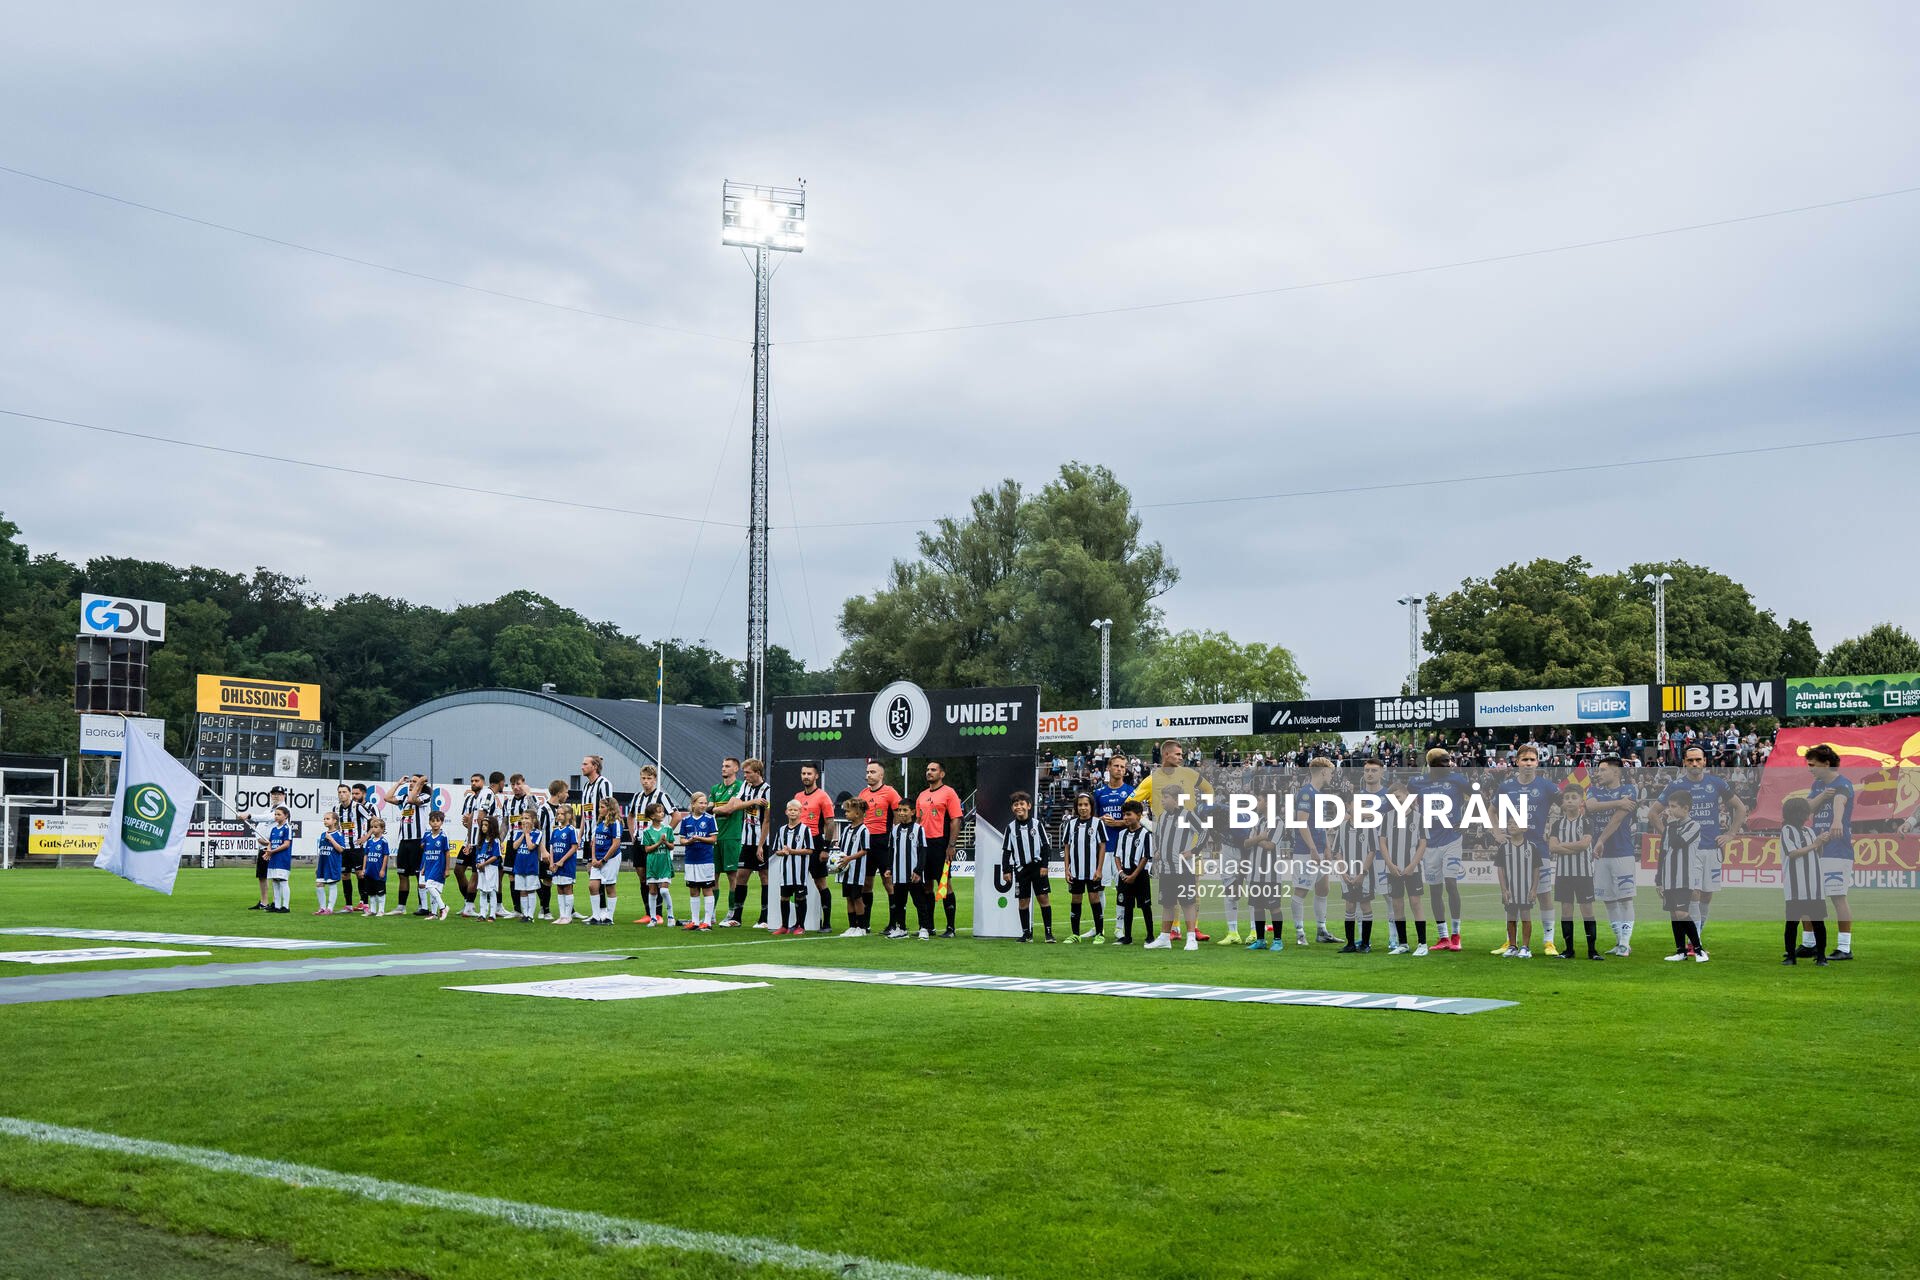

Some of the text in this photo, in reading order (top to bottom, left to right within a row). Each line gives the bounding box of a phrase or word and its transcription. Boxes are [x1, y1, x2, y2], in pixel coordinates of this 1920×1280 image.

[85, 600, 161, 637] GDL
[221, 688, 287, 707] OHLSSONS
[1685, 682, 1772, 711] BBM
[1796, 691, 1863, 701] Allmän nytta.
[1374, 697, 1459, 721] infosign
[1480, 704, 1554, 714] Handelsbanken
[1581, 699, 1626, 713] Haldex
[1796, 700, 1871, 710] För allas bästa.
[786, 709, 855, 729] UNIBET
[946, 702, 1022, 724] UNIBET
[1294, 715, 1340, 724] Mäklarhuset
[1662, 710, 1706, 718] BORSTAHUSENS
[1112, 716, 1148, 732] prenad
[1156, 714, 1248, 727] LOKALTIDNINGEN
[86, 728, 160, 740] BORGWER
[235, 788, 314, 812] graitor
[1692, 802, 1714, 810] ELLBY
[124, 816, 164, 837] SUPERETTAN
[40, 839, 62, 848] Guts
[74, 839, 98, 850] Glory
[211, 840, 235, 850] KEBY
[236, 838, 258, 850] MÖBL
